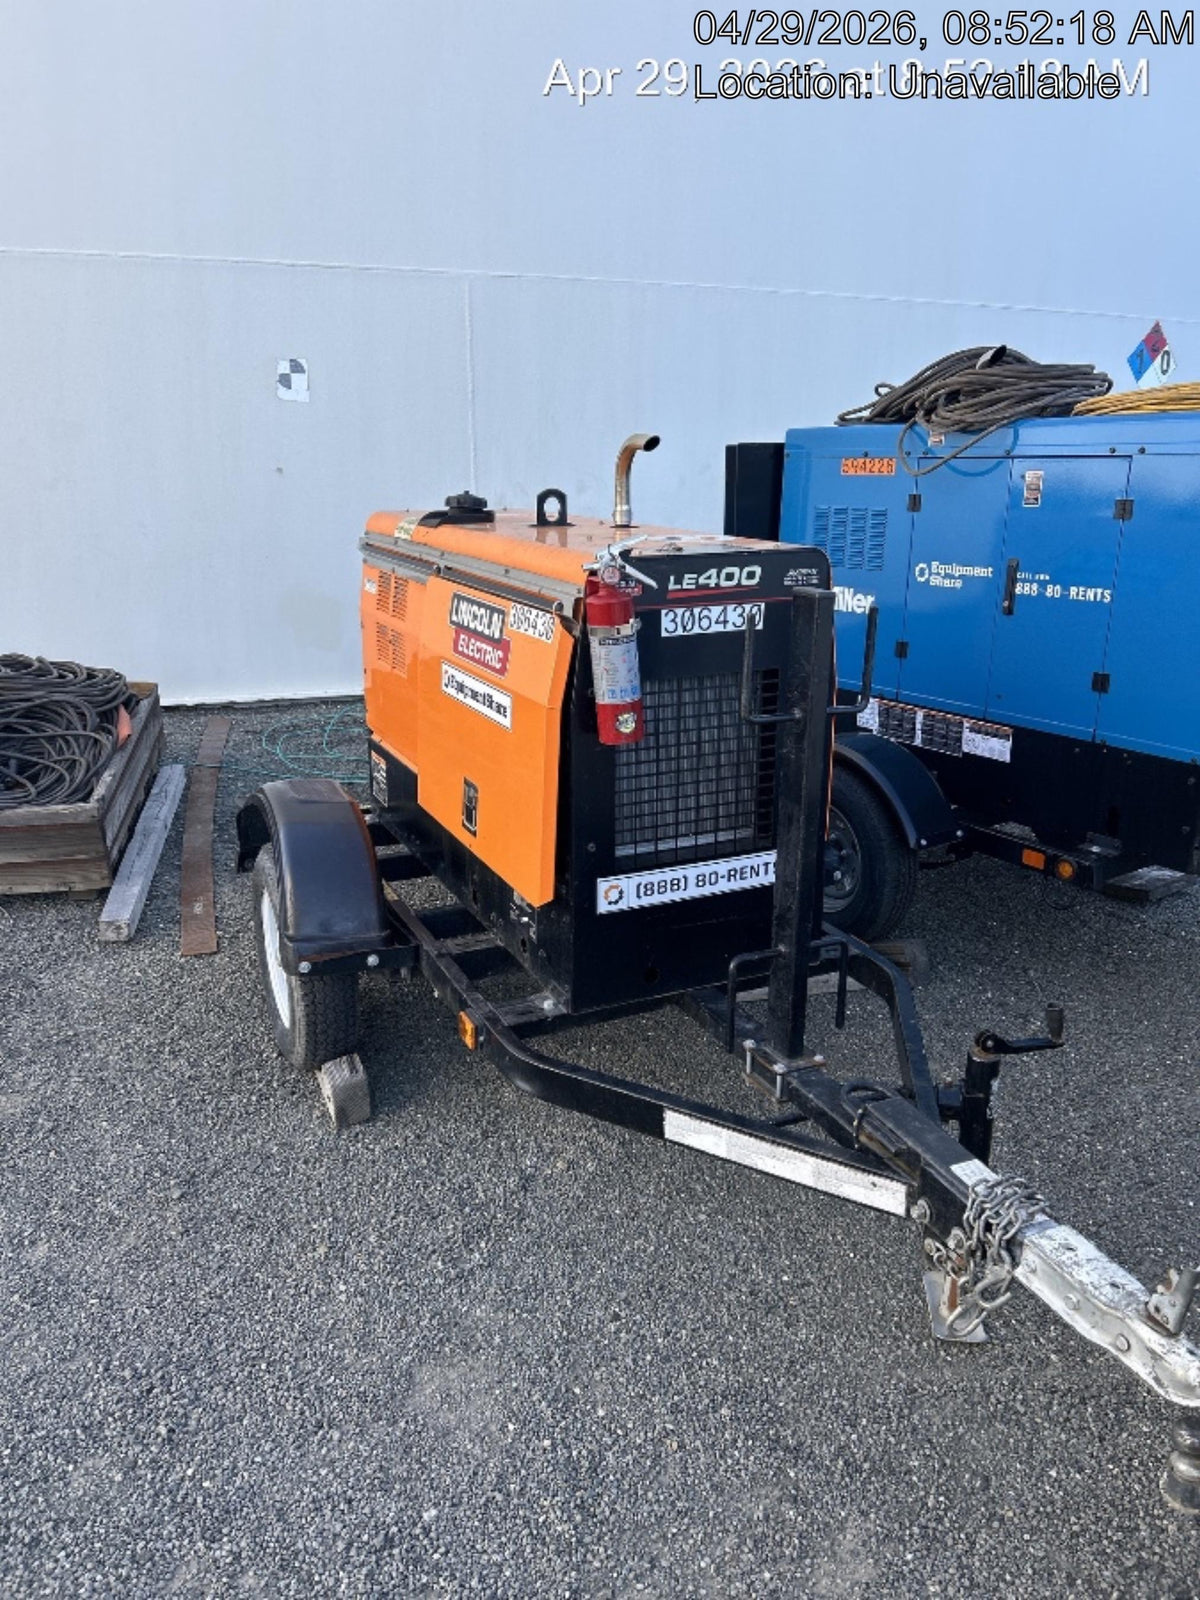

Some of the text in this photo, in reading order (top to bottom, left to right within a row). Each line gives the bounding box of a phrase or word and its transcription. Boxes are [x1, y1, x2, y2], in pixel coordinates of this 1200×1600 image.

[668, 565, 762, 590] LE400
[929, 575, 963, 589] Share
[930, 561, 994, 577] Equipment
[451, 598, 503, 640] LINCOLN
[663, 603, 763, 635] 306430
[458, 633, 503, 670] ELECTRIC
[635, 861, 777, 900] (888) 80-RENT
